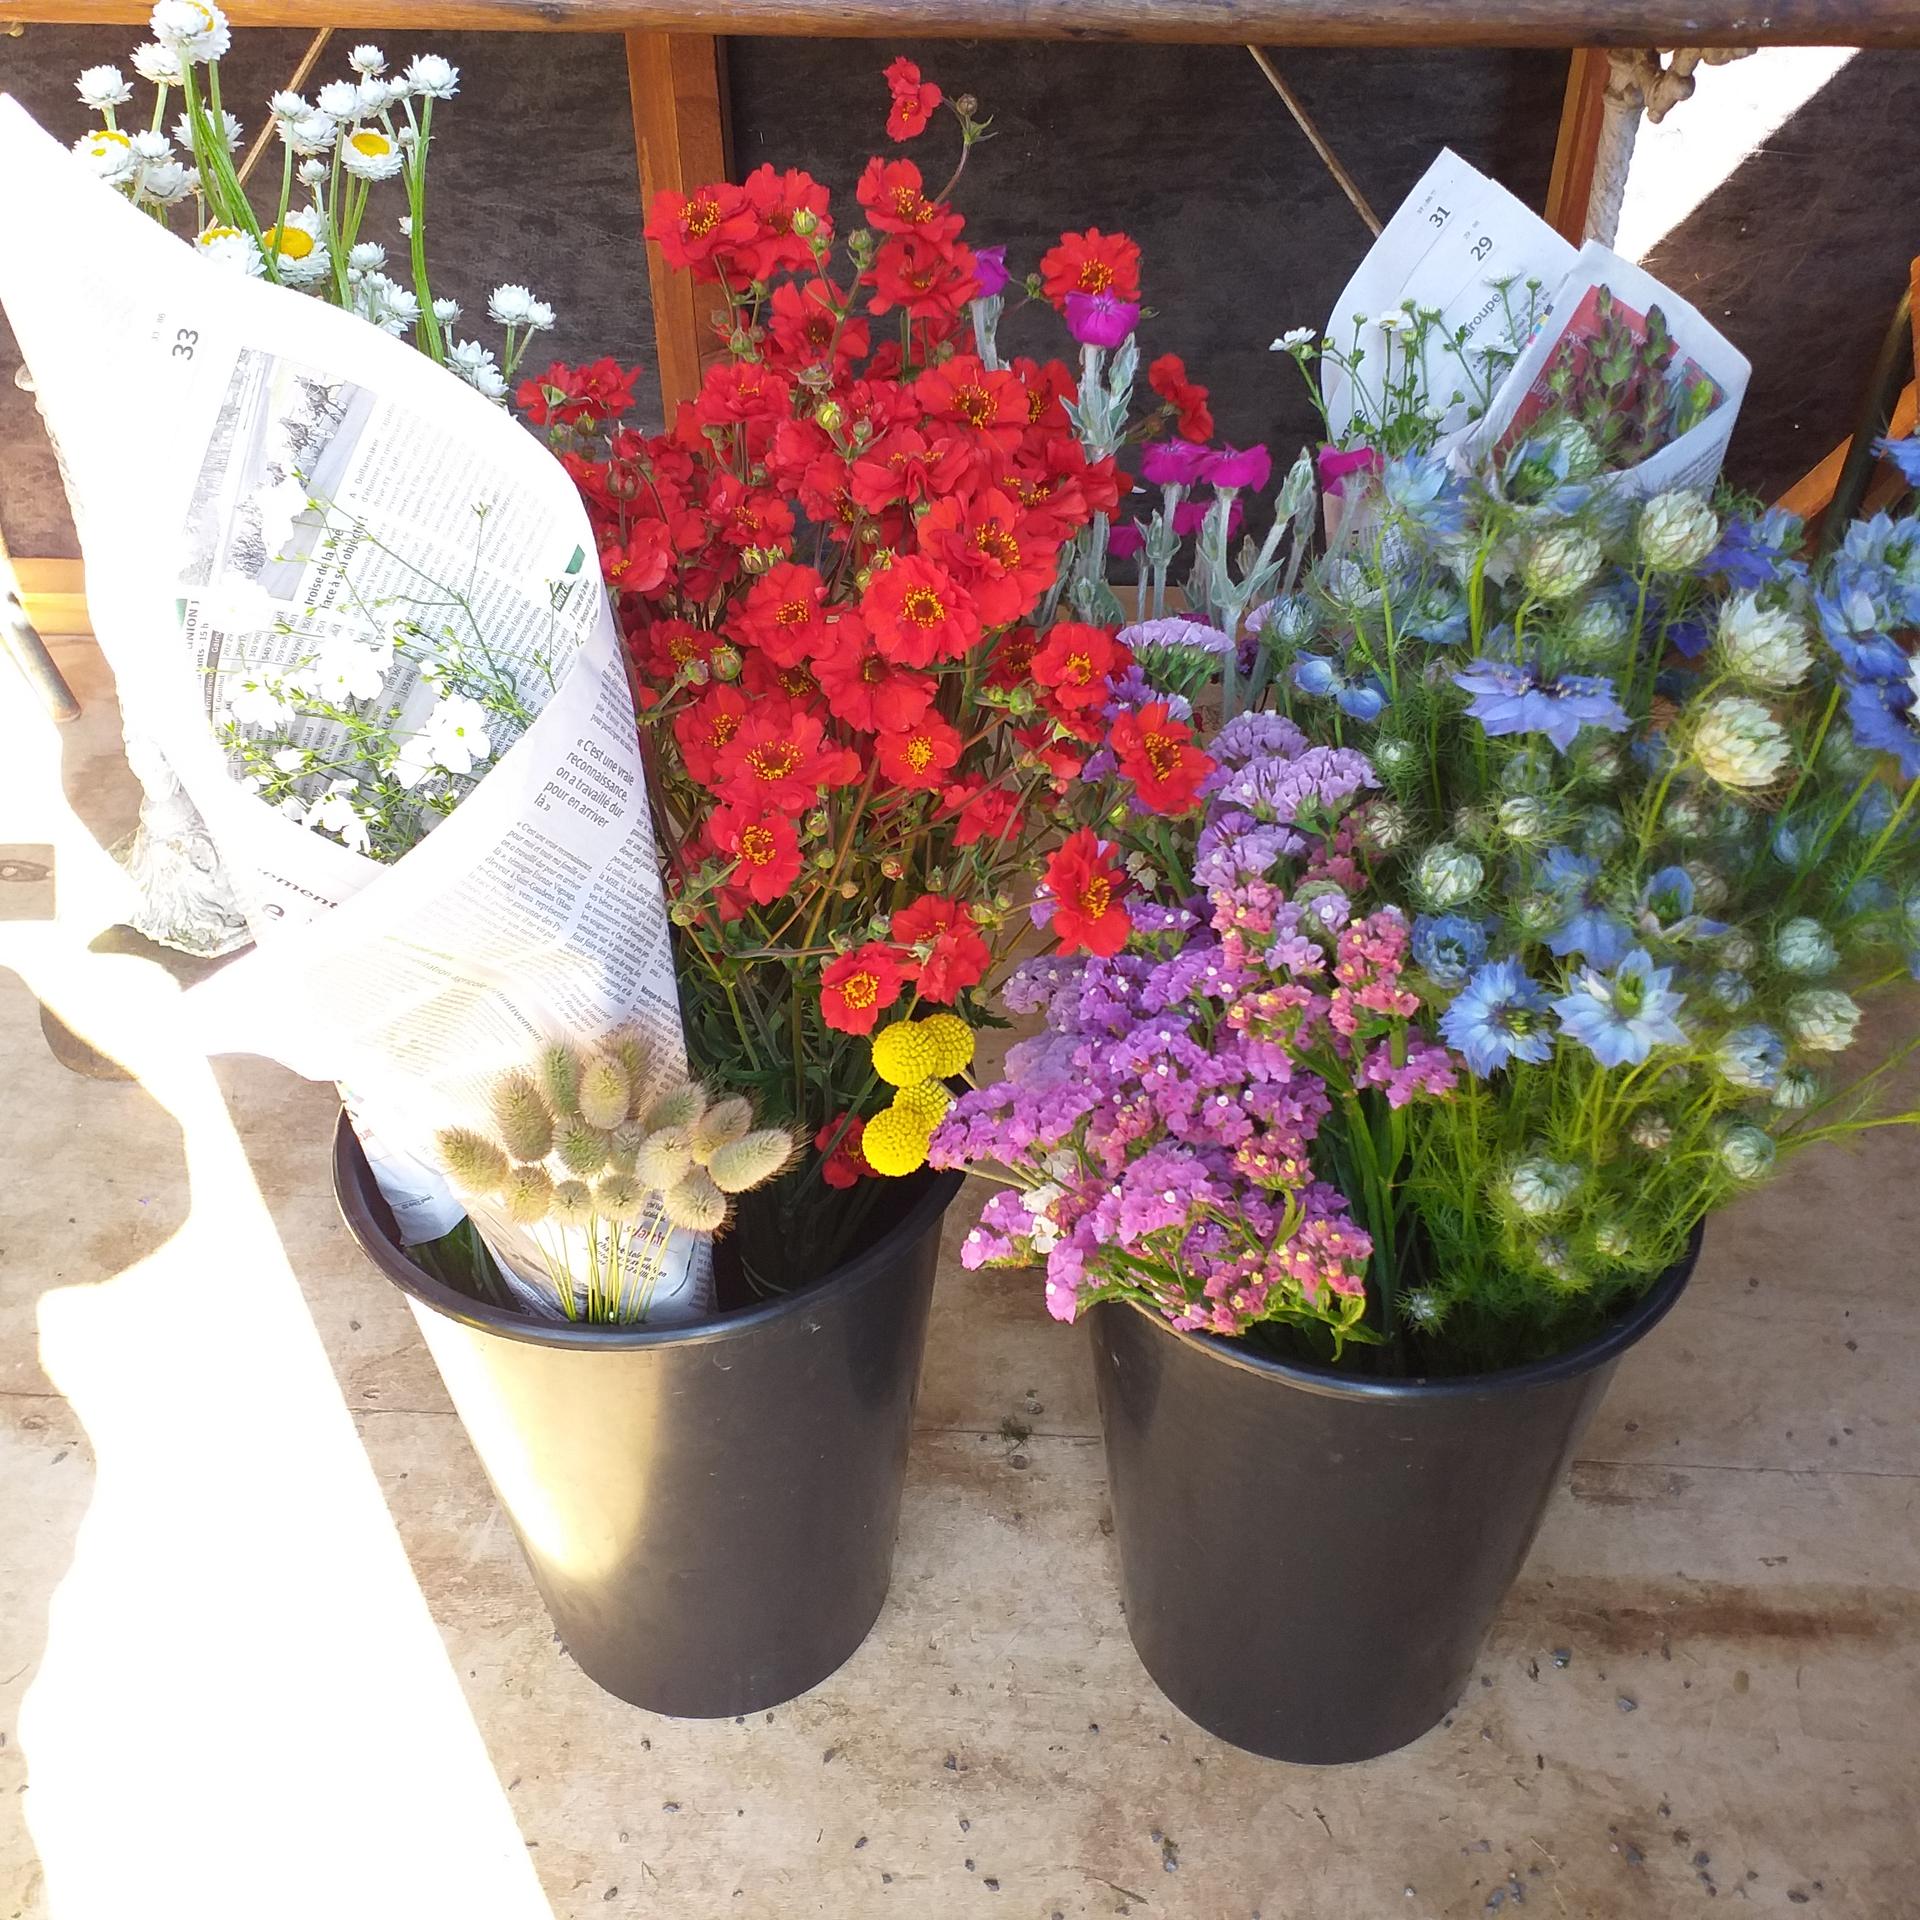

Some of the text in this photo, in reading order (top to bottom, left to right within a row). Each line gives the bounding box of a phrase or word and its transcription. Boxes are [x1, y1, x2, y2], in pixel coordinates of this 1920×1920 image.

[1429, 206, 1451, 228] 31
[1470, 236, 1493, 262] 29
[170, 326, 199, 360] 33
[321, 549, 334, 562] la
[315, 561, 330, 576] de
[302, 575, 324, 606] Iroise
[327, 578, 340, 588] à
[319, 587, 337, 610] face
[199, 630, 207, 640] 15
[580, 738, 607, 762] C'est
[600, 755, 620, 773] une
[614, 764, 638, 787] vraie
[564, 749, 634, 803] reconnaissance,
[534, 792, 548, 808] là
[555, 765, 626, 819] on a travaillé dur
[543, 780, 570, 804] pour
[566, 795, 581, 810] en
[577, 800, 611, 829] arriver
[506, 829, 525, 845] pour
